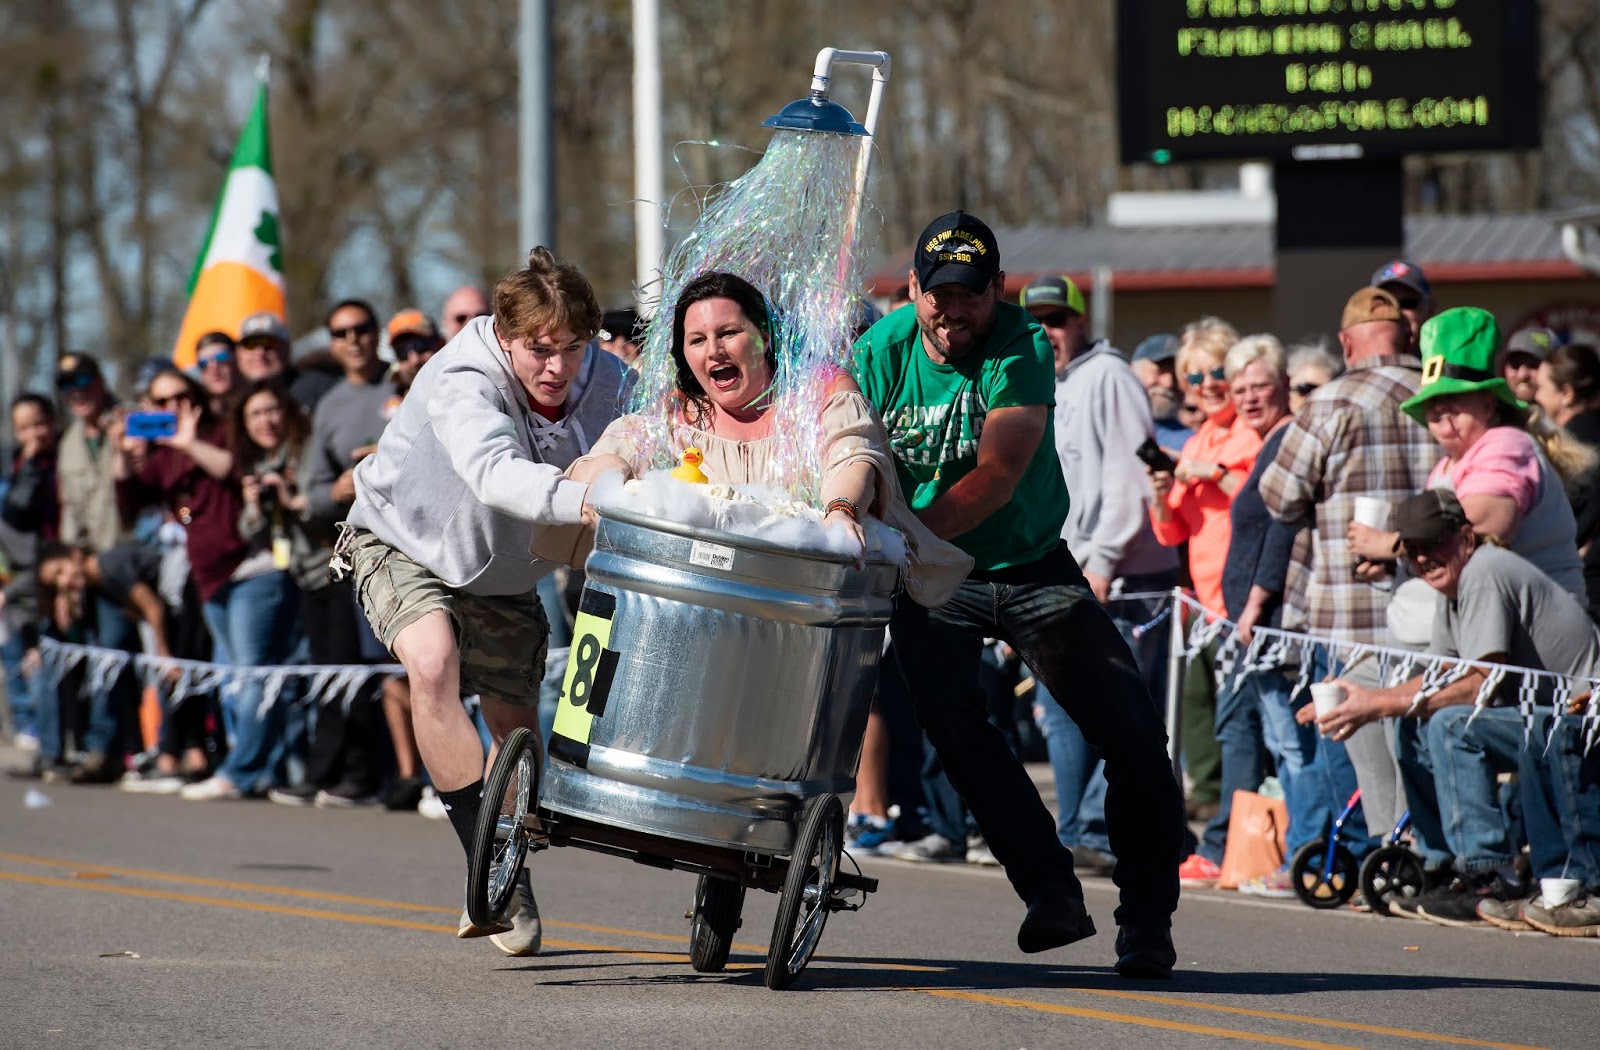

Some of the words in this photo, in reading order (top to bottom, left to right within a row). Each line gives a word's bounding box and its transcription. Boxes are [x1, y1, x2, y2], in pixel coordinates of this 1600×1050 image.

[925, 237, 939, 253] USS
[939, 229, 988, 256] PHILADELPHIA
[938, 252, 972, 263] SSN-690
